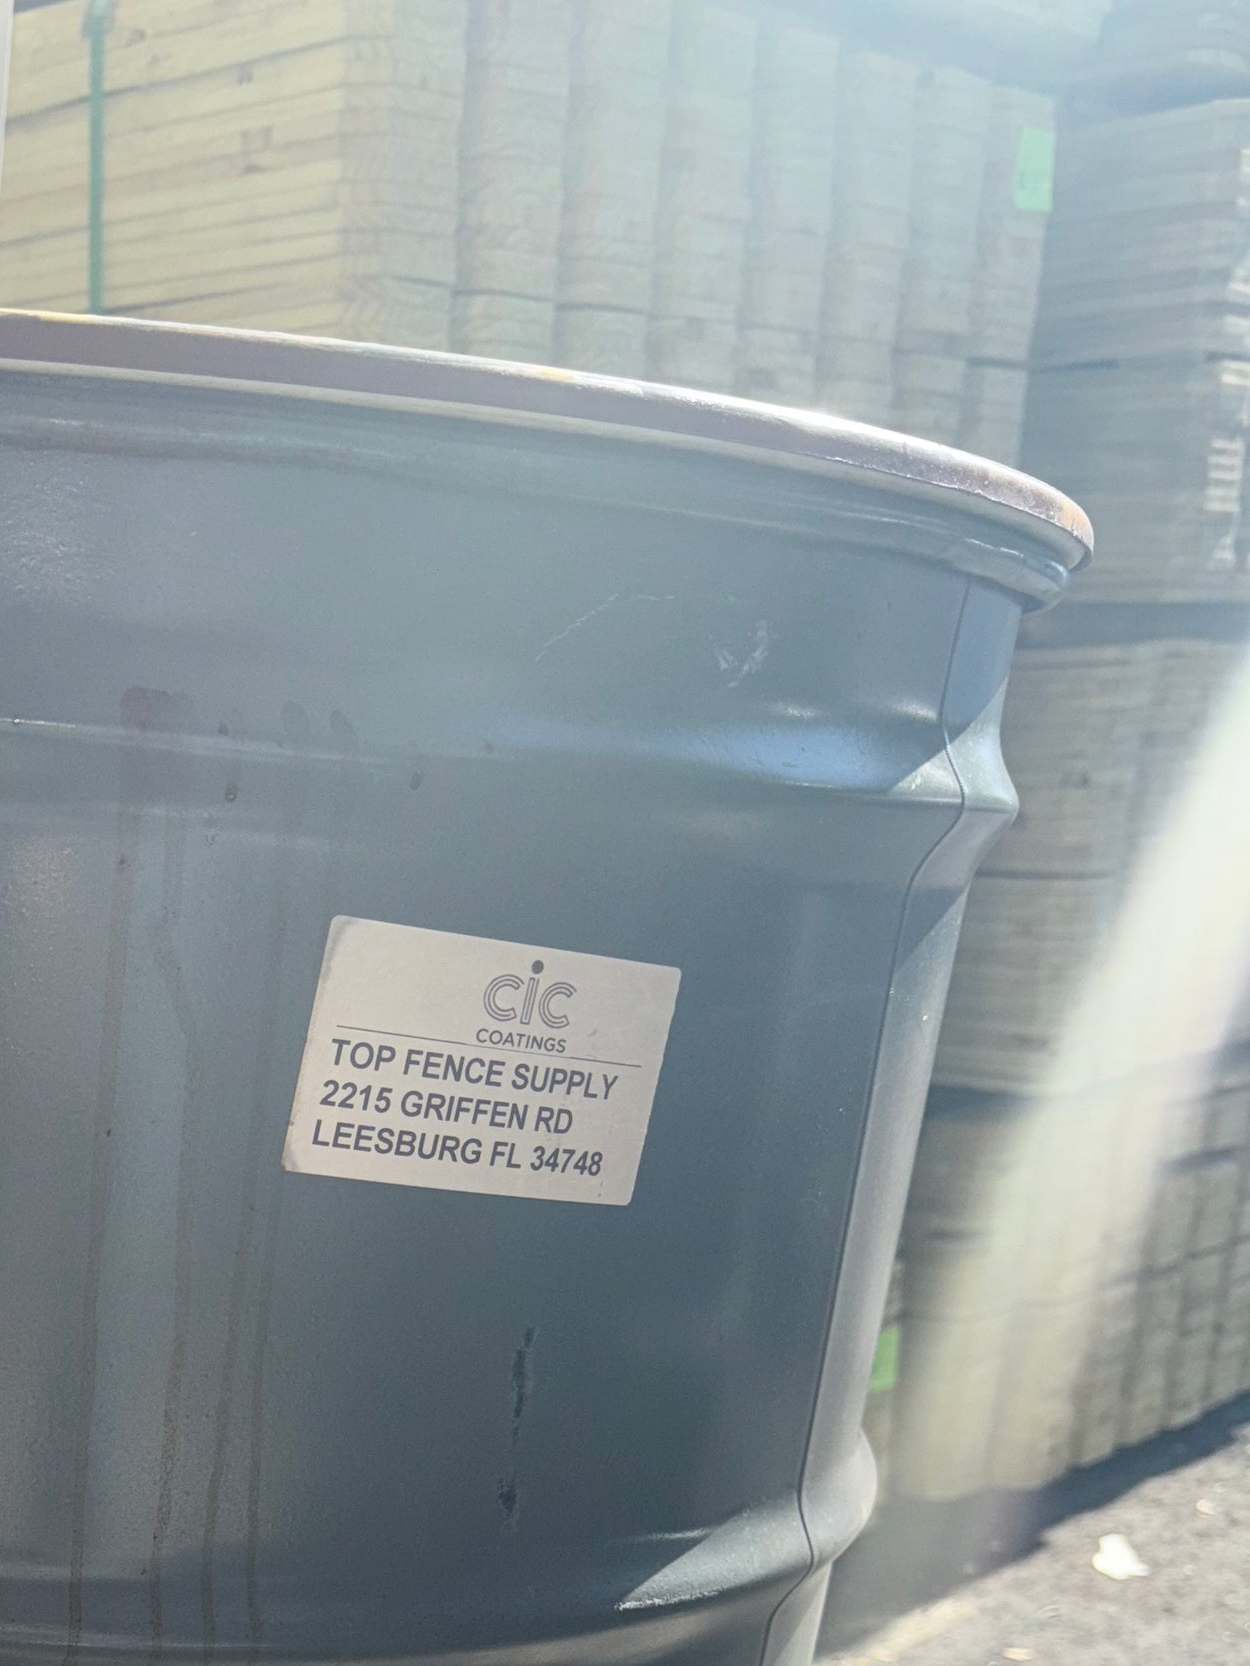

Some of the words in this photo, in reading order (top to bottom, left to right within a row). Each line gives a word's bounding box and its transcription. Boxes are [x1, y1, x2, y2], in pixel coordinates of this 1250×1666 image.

[476, 1028, 566, 1053] COATINGS
[331, 1038, 395, 1072] TOP
[404, 1049, 506, 1087] FENCE
[511, 1064, 618, 1099] SUPPLY
[320, 1080, 392, 1112] 2215
[401, 1090, 529, 1130] GRIFFEN
[534, 1108, 573, 1134] RD
[312, 1120, 482, 1164] LEESBURG
[490, 1141, 521, 1169] FL
[530, 1145, 603, 1176] 34748
